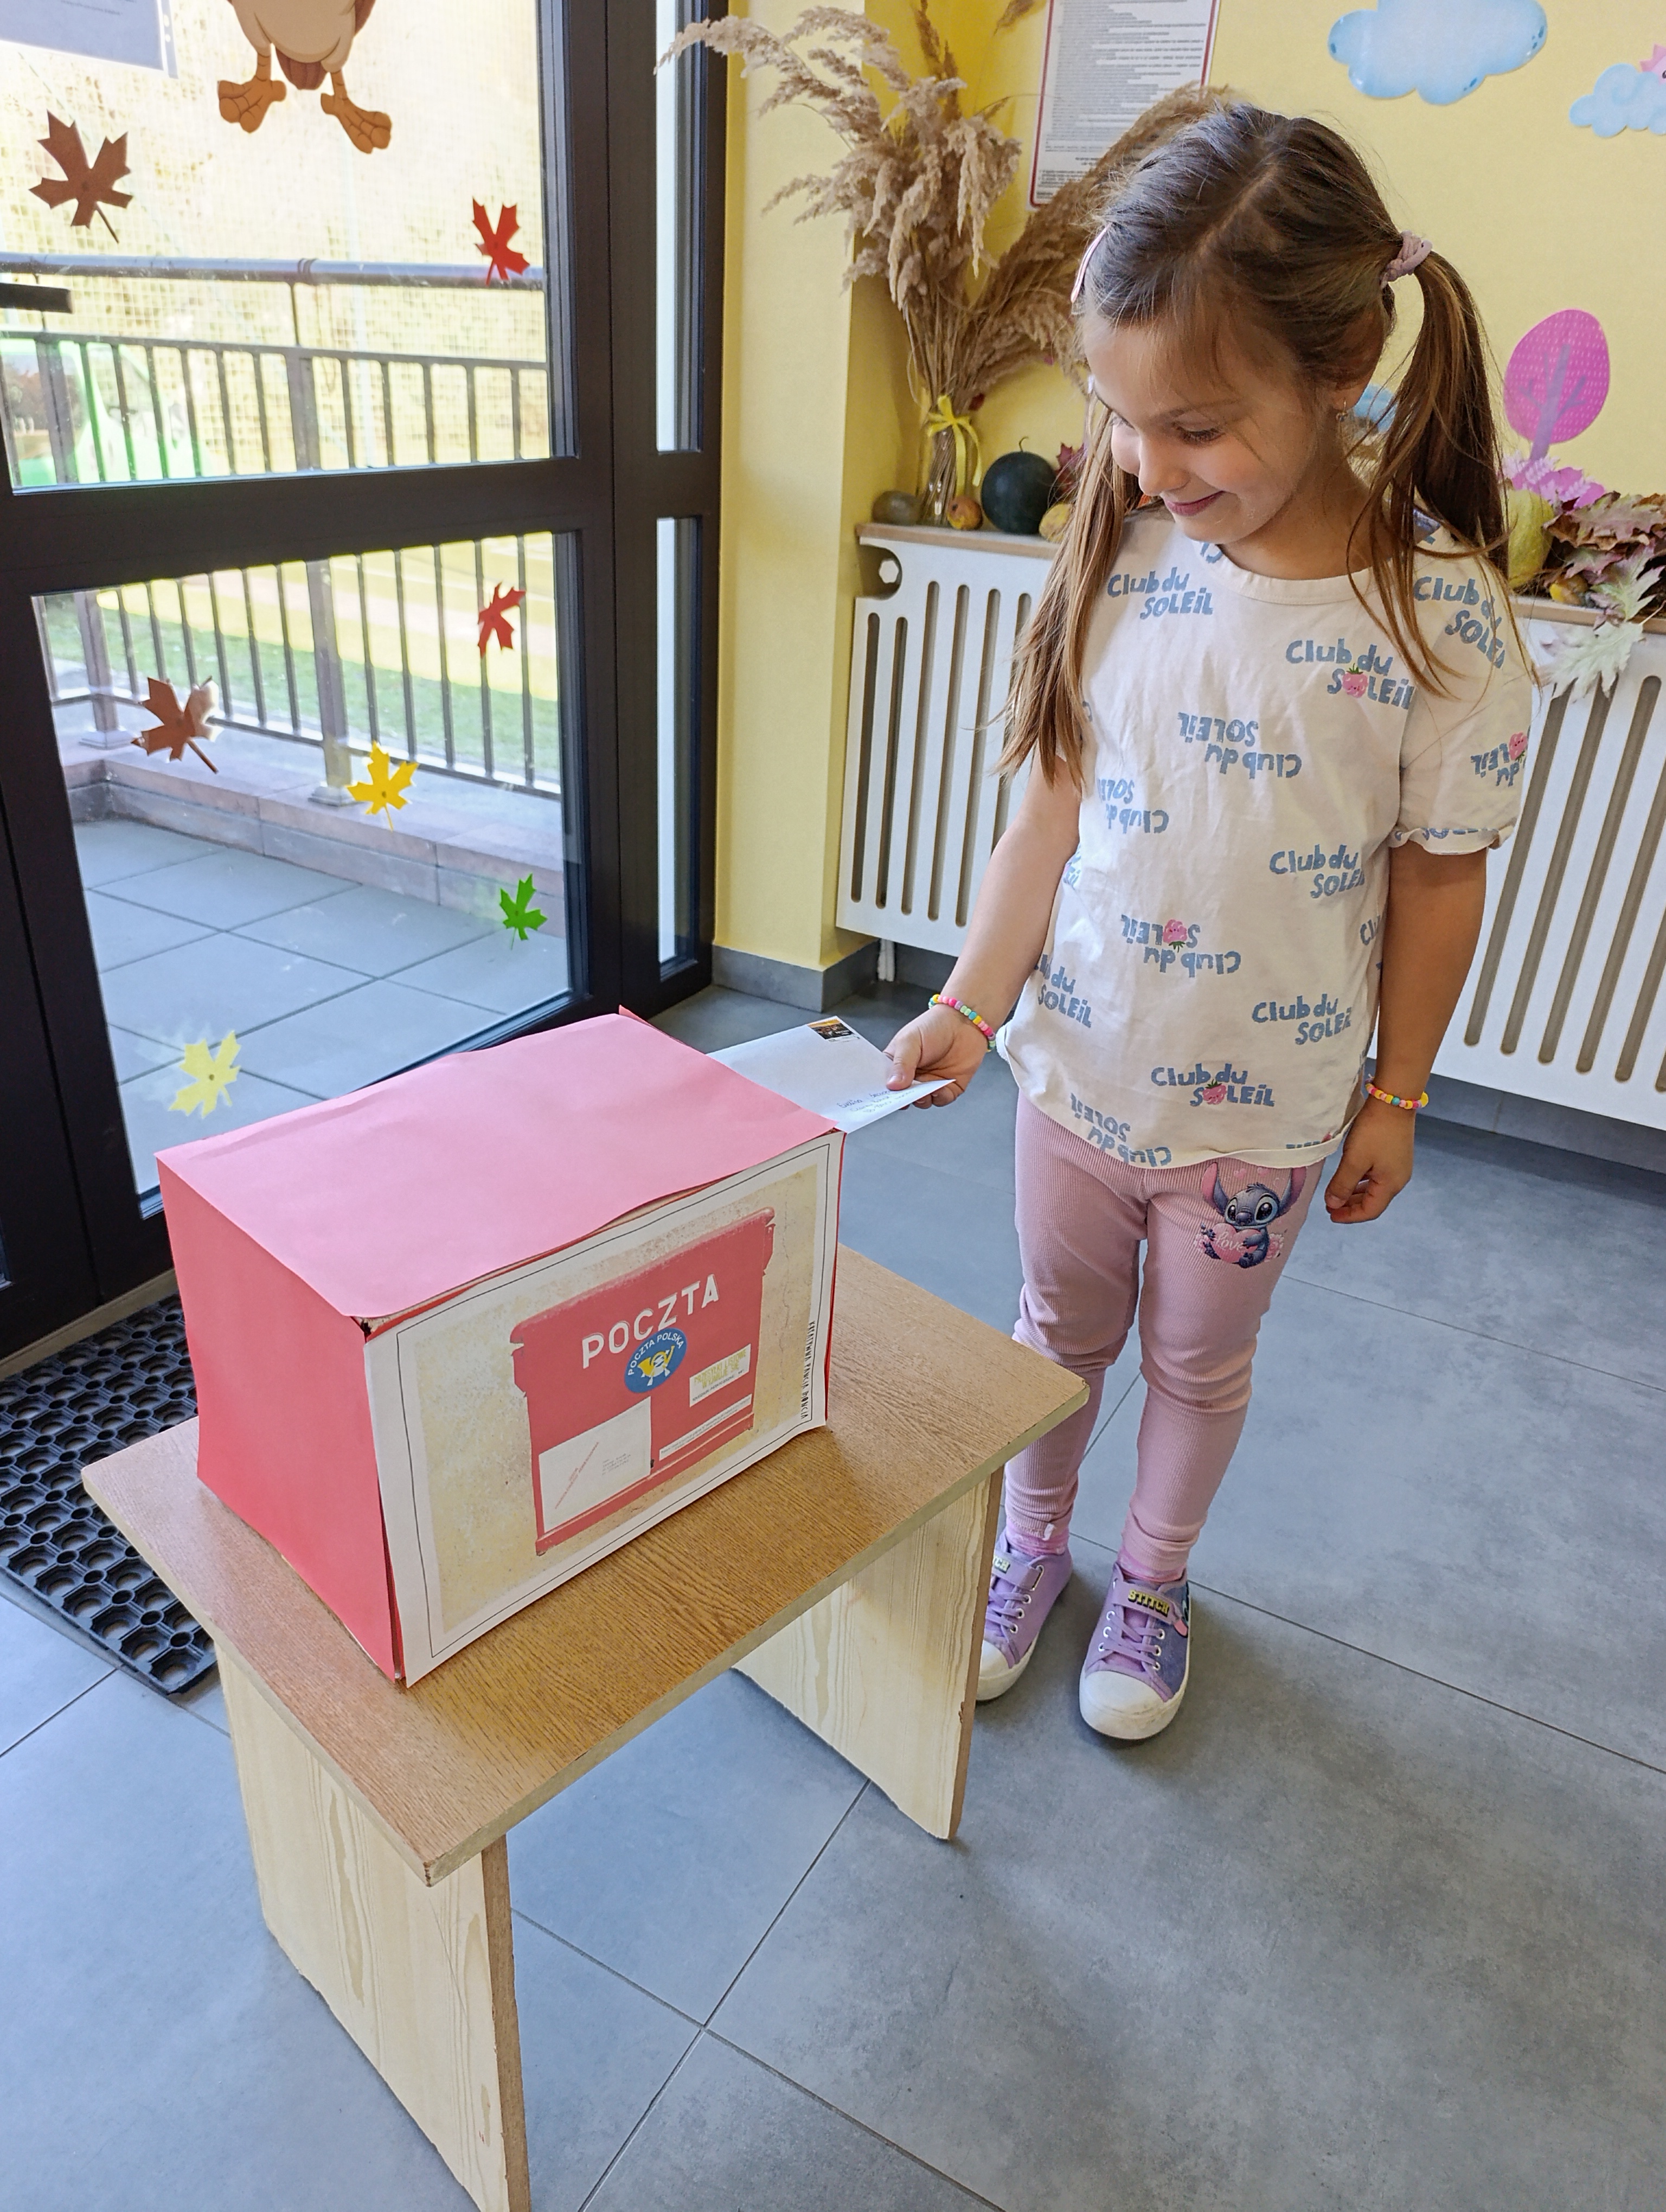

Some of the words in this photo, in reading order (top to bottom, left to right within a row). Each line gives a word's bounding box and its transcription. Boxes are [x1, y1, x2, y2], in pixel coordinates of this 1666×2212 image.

[1107, 570, 1159, 597] Club
[1162, 567, 1190, 591] du
[1413, 576, 1480, 606] Club
[1285, 638, 1352, 664] Club
[1357, 644, 1393, 676] du
[1204, 743, 1239, 775] du
[1242, 751, 1302, 780] Club
[1119, 808, 1169, 834] Club
[1269, 844, 1326, 874] Club
[1328, 844, 1359, 870] du
[1143, 947, 1176, 973] du
[1181, 950, 1241, 978] Club
[1252, 995, 1311, 1023] Club
[1312, 993, 1338, 1018] du
[1151, 1063, 1211, 1086] Club
[1215, 1063, 1248, 1084] du
[582, 1274, 719, 1369] POCZTA
[627, 1339, 655, 1375] POCZTA
[657, 1332, 684, 1349] POLSKA
[1127, 1589, 1169, 1617] STITCH
